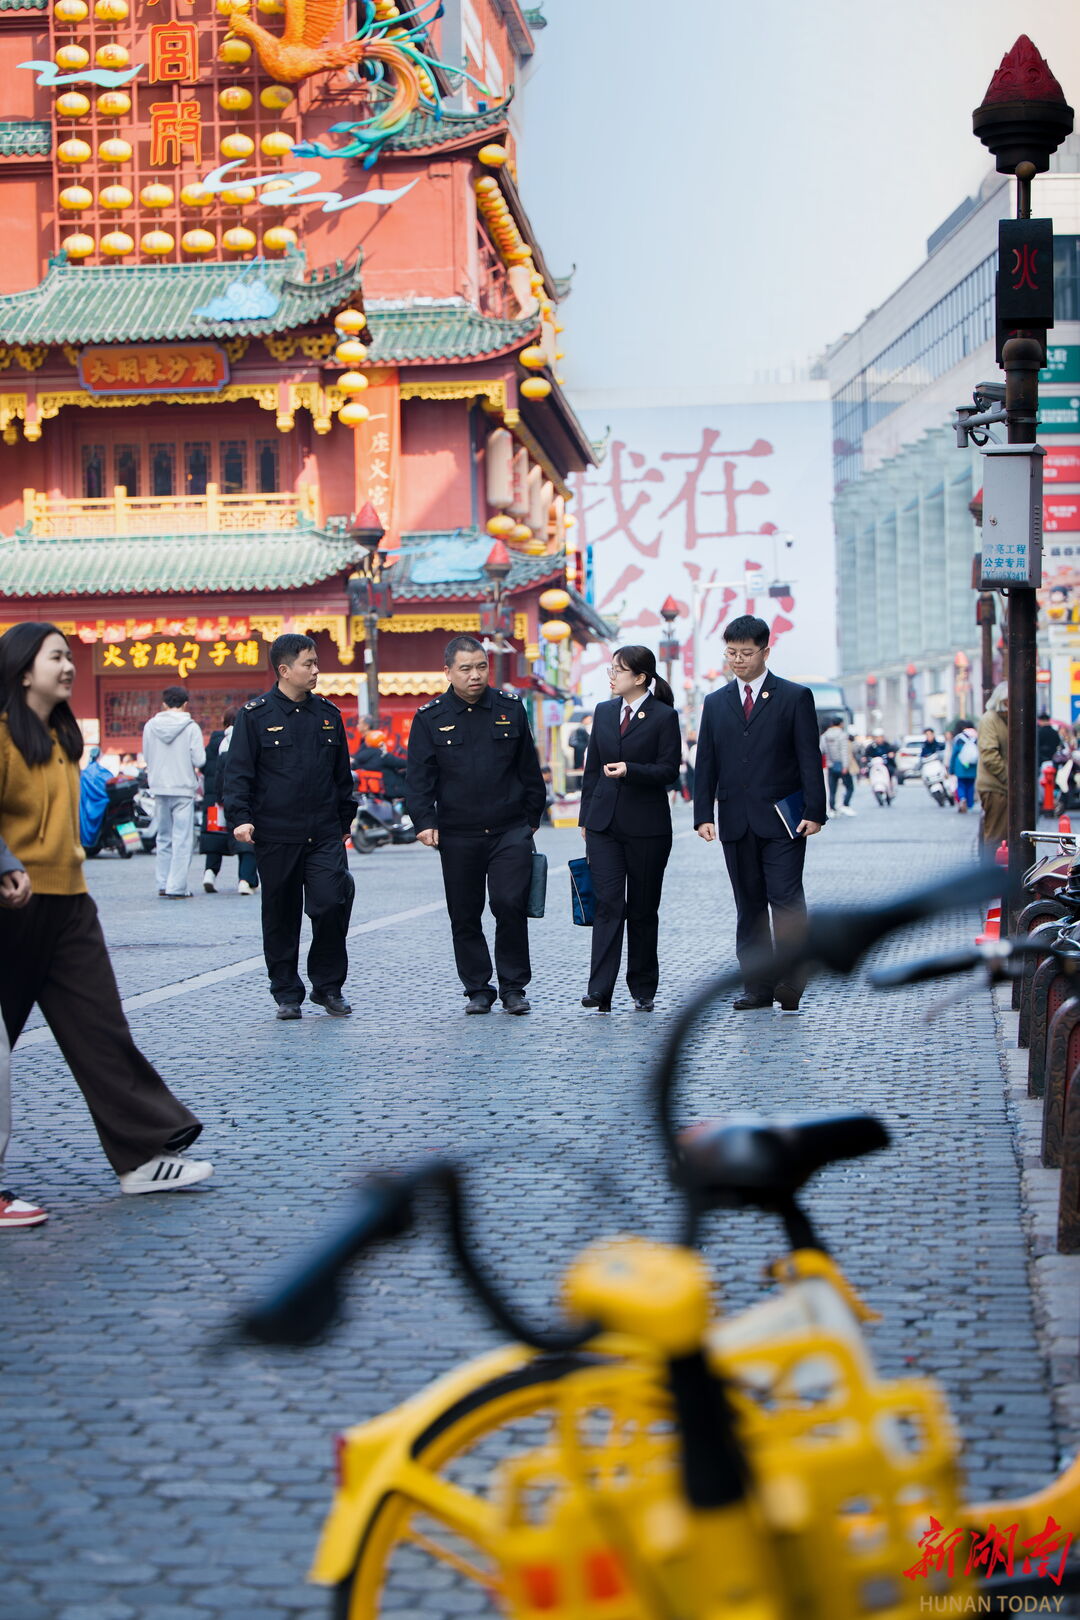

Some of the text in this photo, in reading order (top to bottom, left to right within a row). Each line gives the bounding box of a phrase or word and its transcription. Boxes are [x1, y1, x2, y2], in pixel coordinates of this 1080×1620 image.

[984, 543, 1027, 555] 亮工程
[984, 557, 1026, 568] 公安专用
